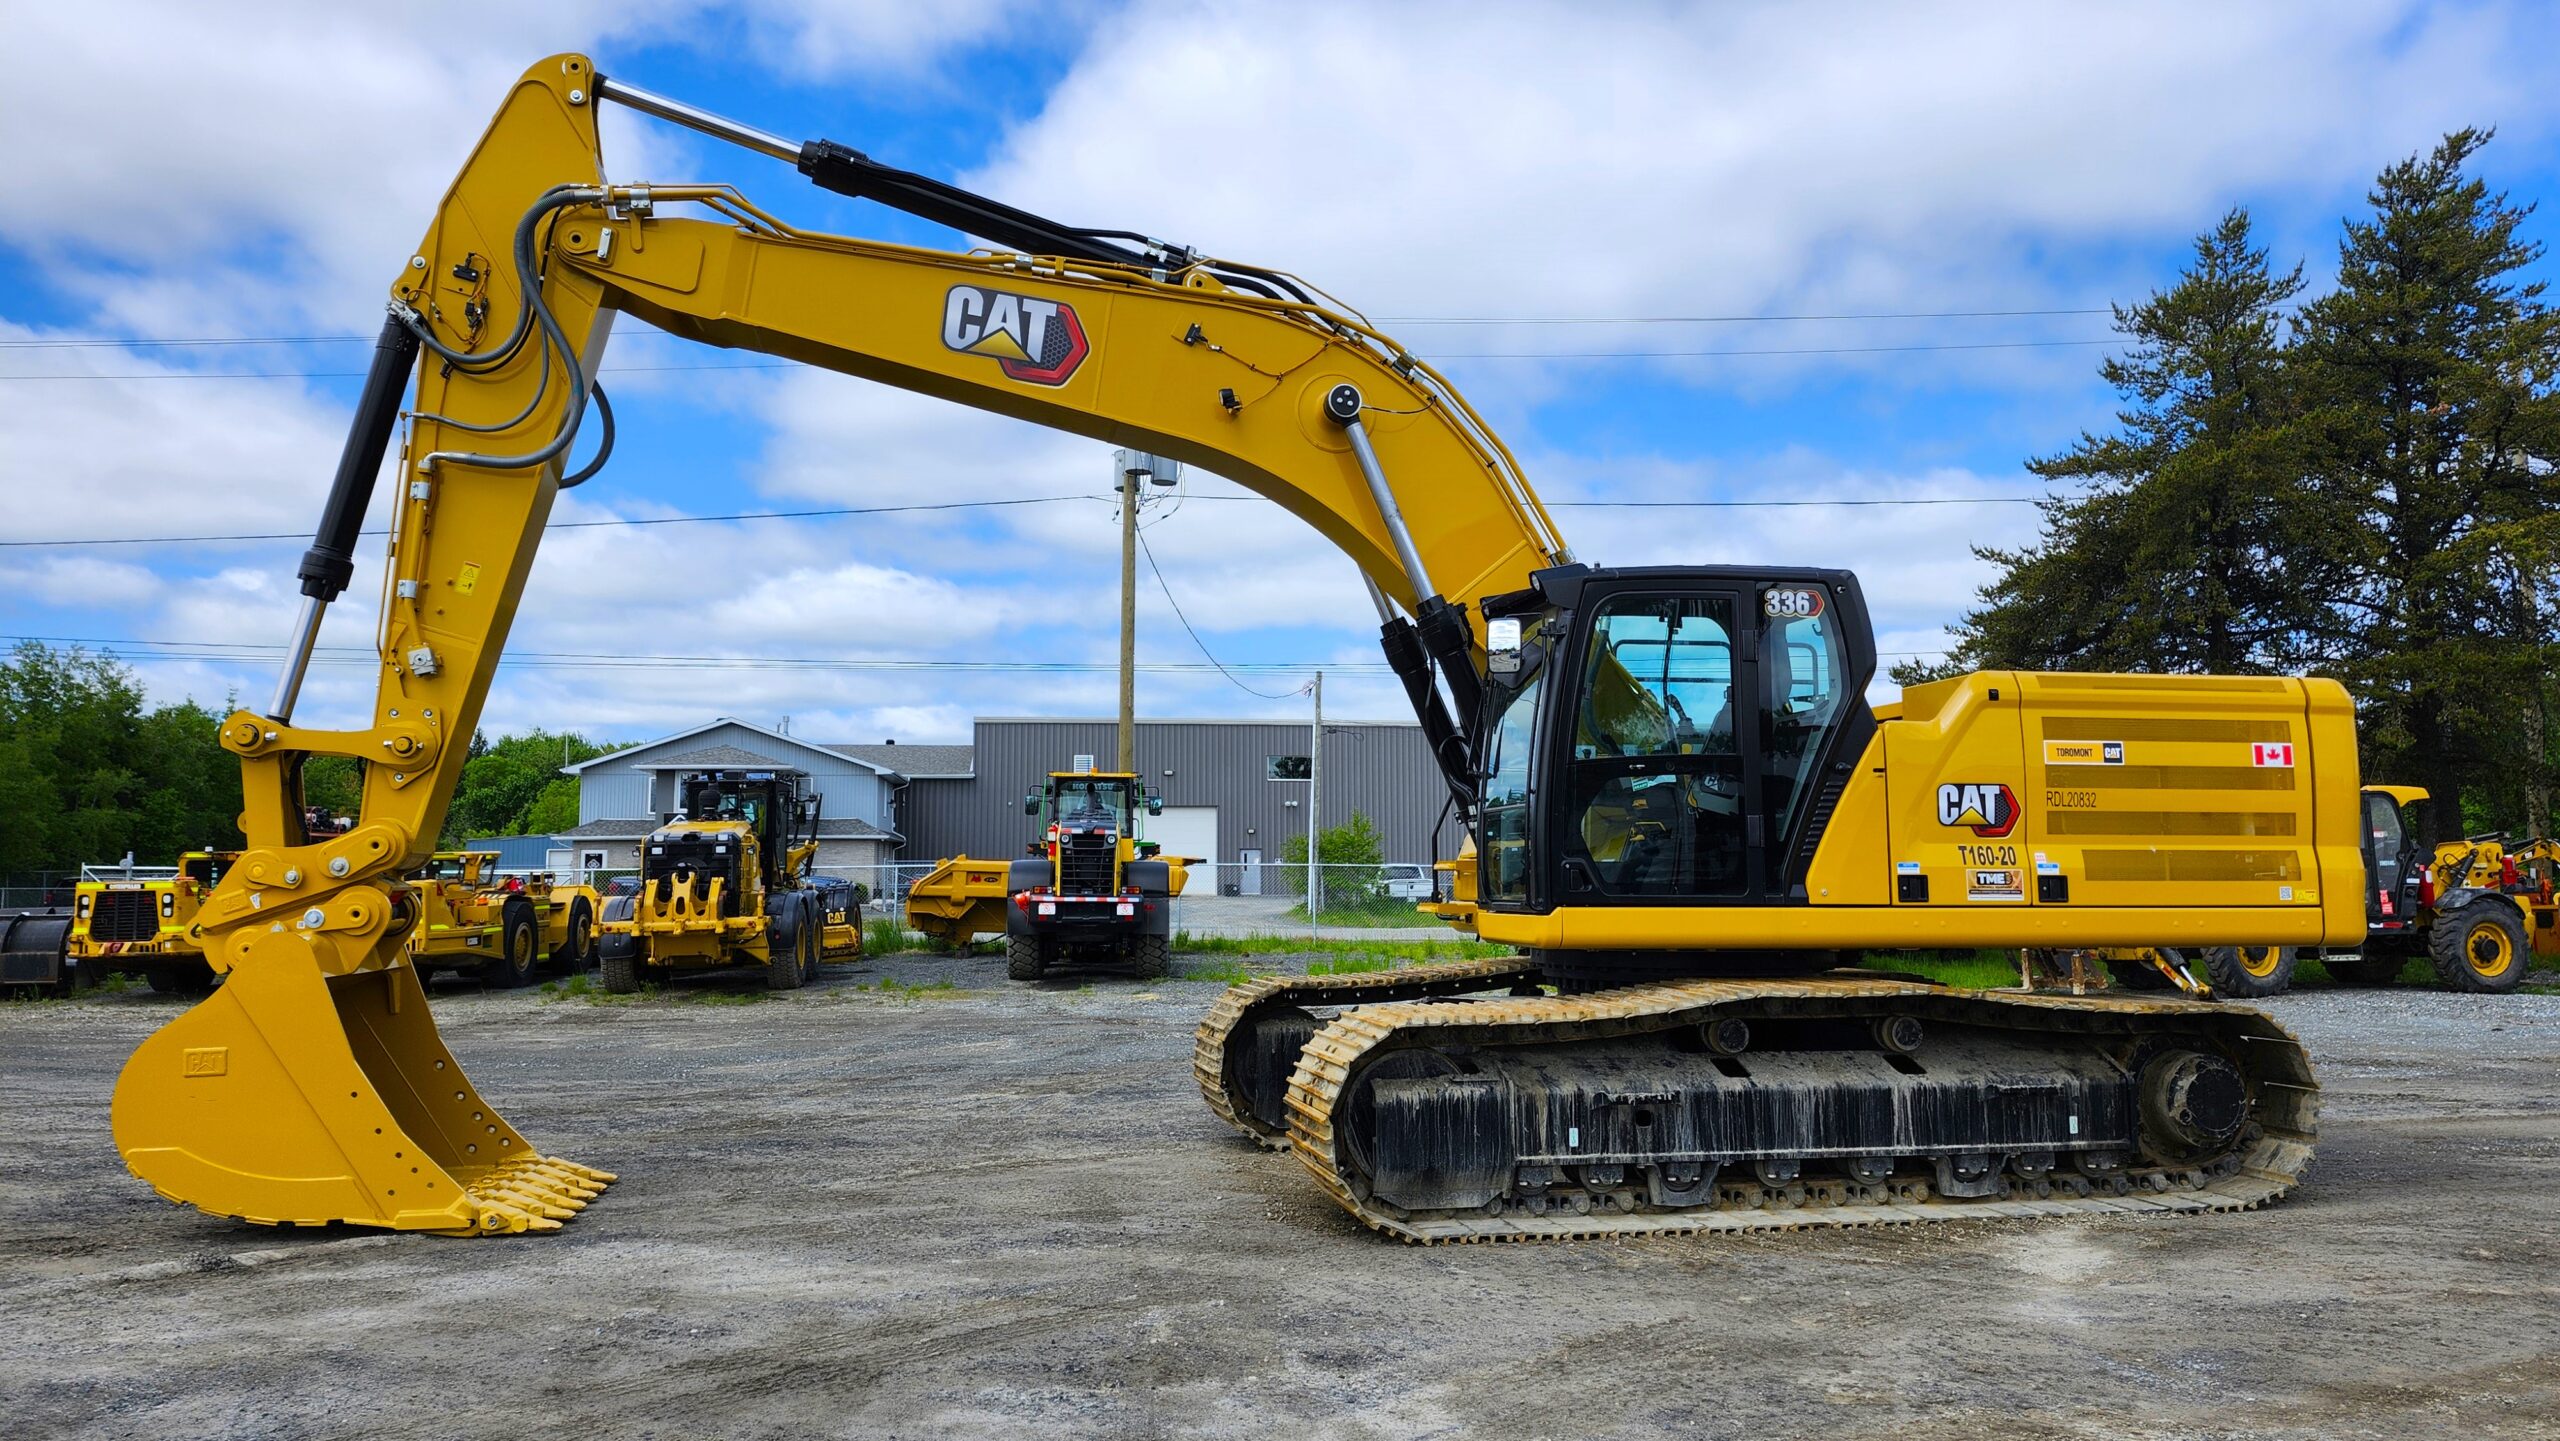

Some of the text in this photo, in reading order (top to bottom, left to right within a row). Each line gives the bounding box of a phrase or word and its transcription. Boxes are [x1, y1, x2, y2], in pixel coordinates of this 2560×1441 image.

[944, 286, 1057, 363] CAT
[1766, 590, 1810, 615] 336
[2056, 746, 2121, 759] TOROMONT CAT
[1072, 782, 1114, 790] KOTSU
[1938, 784, 2000, 825] CAT
[2046, 790, 2097, 808] RDL20832
[1958, 845, 2017, 866] T160-20
[1977, 873, 2005, 885] TME
[827, 911, 846, 924] CAT
[186, 1052, 223, 1073] CAT
